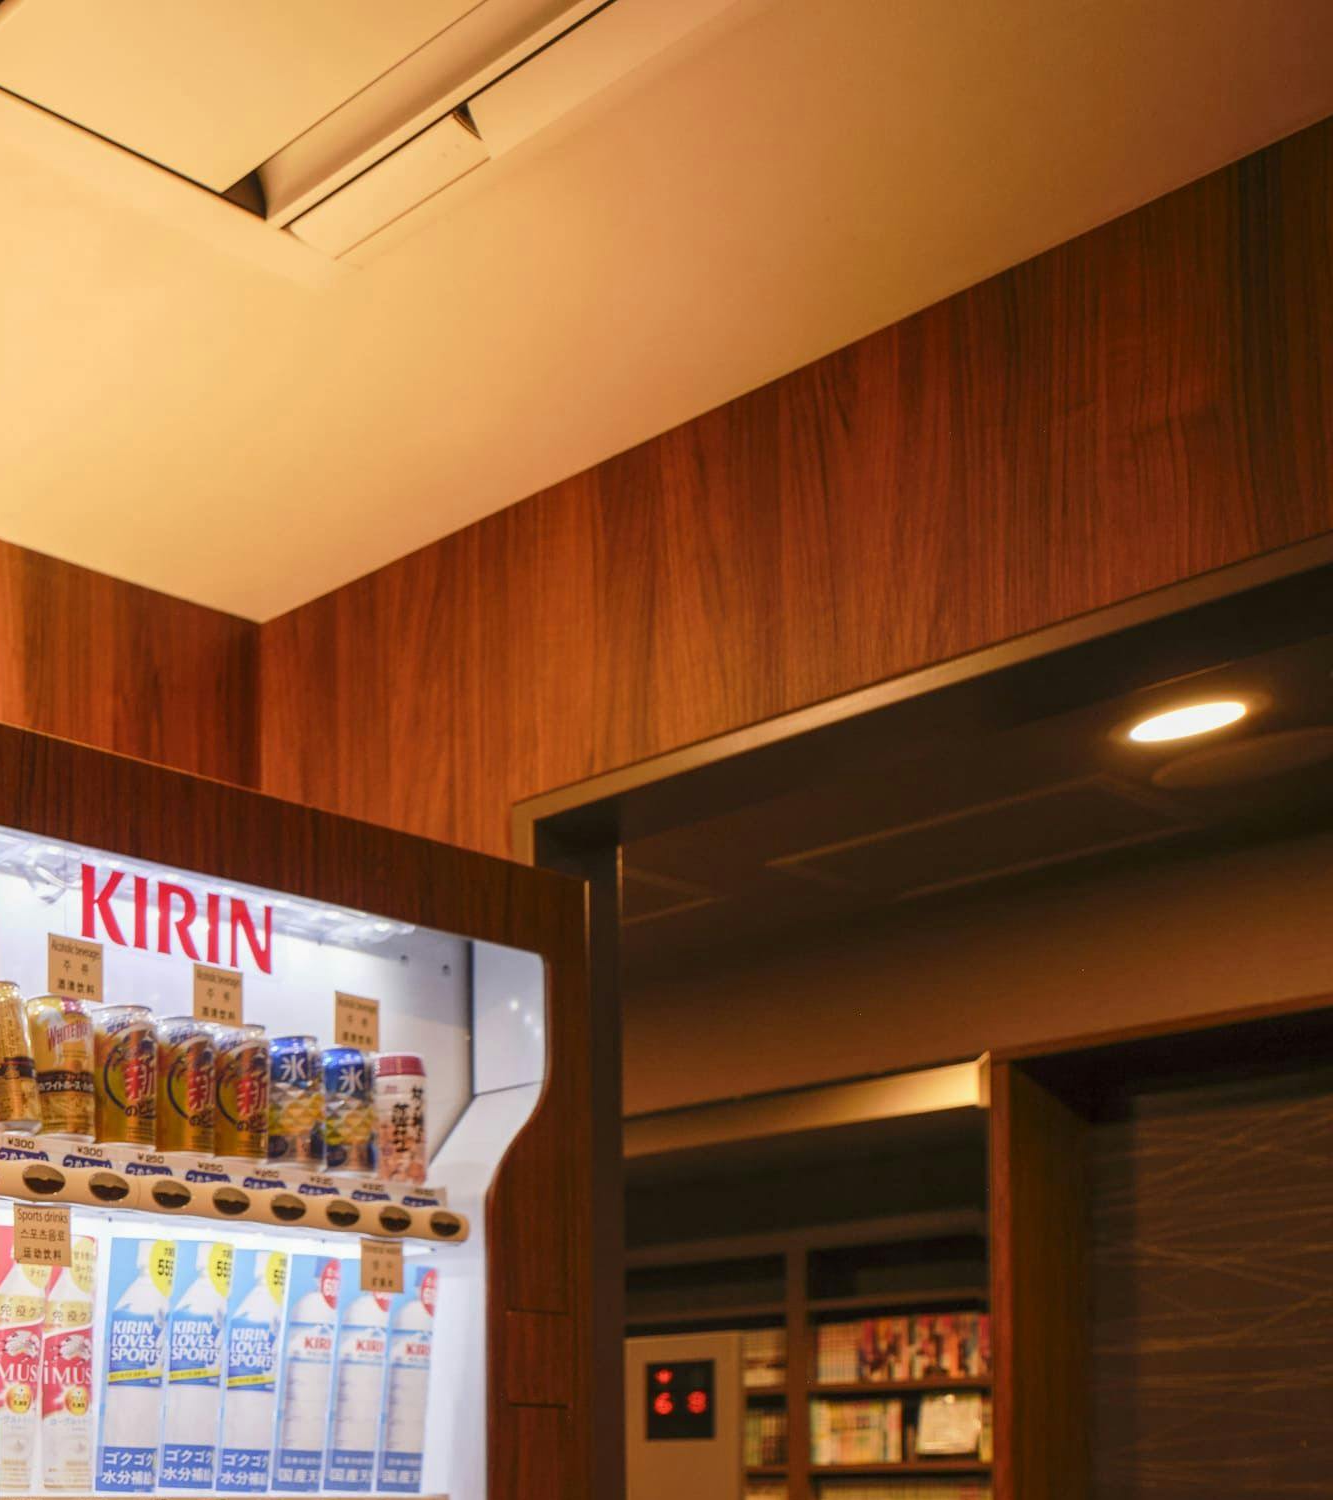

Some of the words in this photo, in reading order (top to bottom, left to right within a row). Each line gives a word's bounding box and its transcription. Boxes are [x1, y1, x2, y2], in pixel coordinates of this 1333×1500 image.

[81, 863, 273, 975] KIRIN
[17, 1208, 42, 1223] Sports
[44, 1210, 68, 1224] drinks
[112, 1320, 154, 1334] KIRIN
[112, 1334, 155, 1349] LOVES
